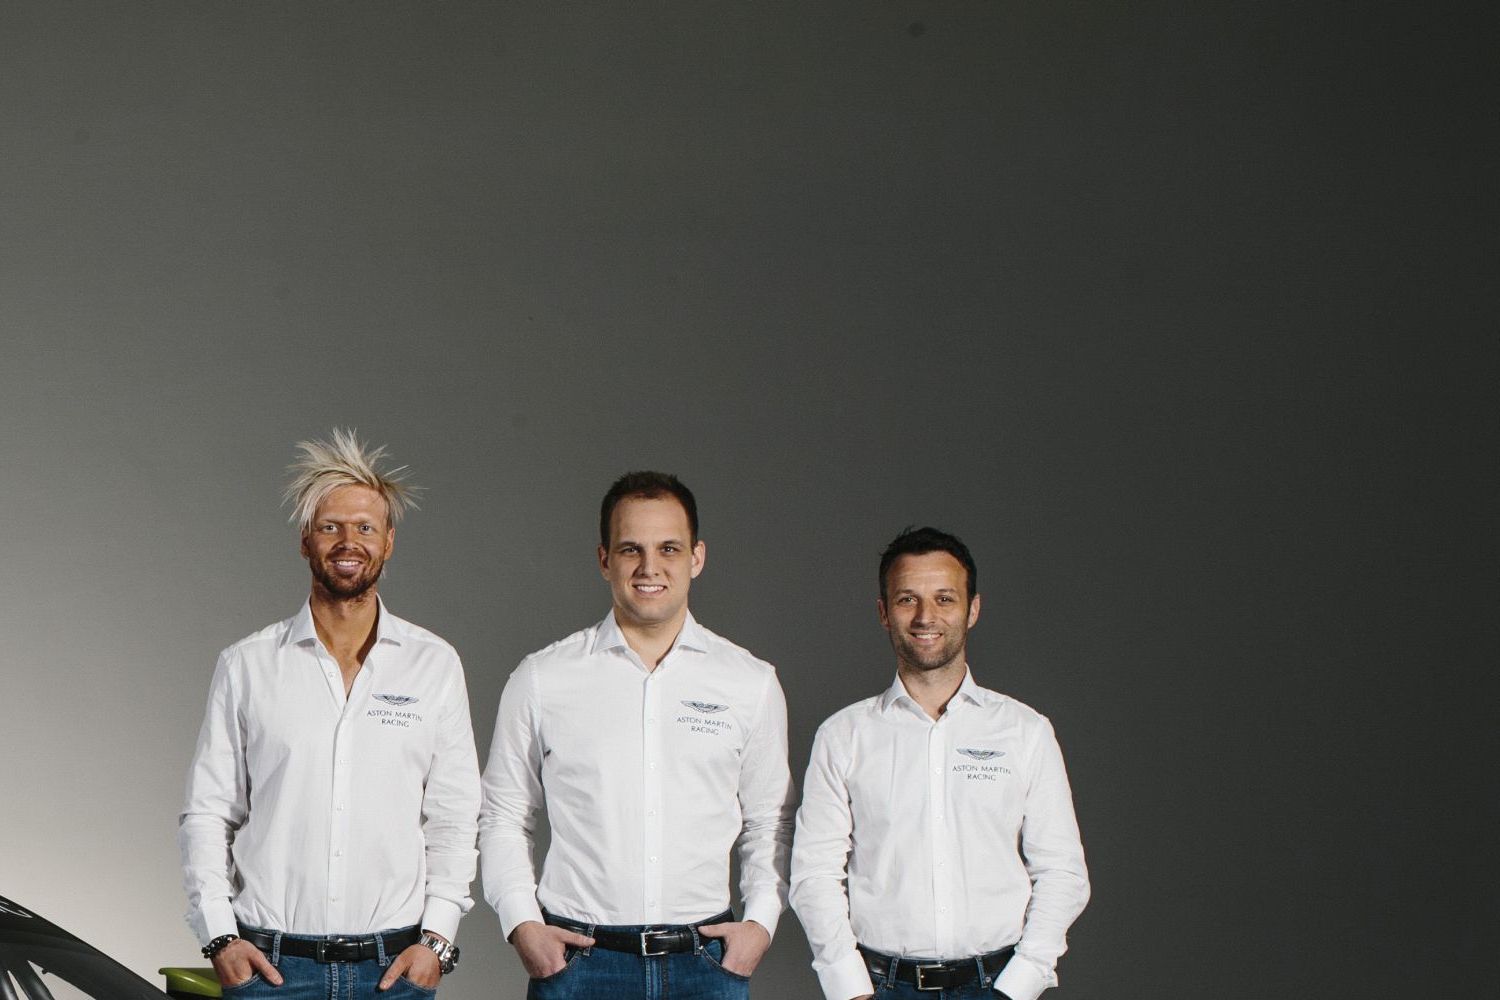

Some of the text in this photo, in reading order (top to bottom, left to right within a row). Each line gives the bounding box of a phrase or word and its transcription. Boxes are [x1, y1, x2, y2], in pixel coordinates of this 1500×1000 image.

[394, 711, 423, 722] MARTIN
[381, 718, 409, 728] RACING
[704, 719, 732, 731] MARTIN
[691, 725, 719, 736] RACING
[980, 765, 1012, 775] MARTIN
[967, 773, 997, 781] RACING
